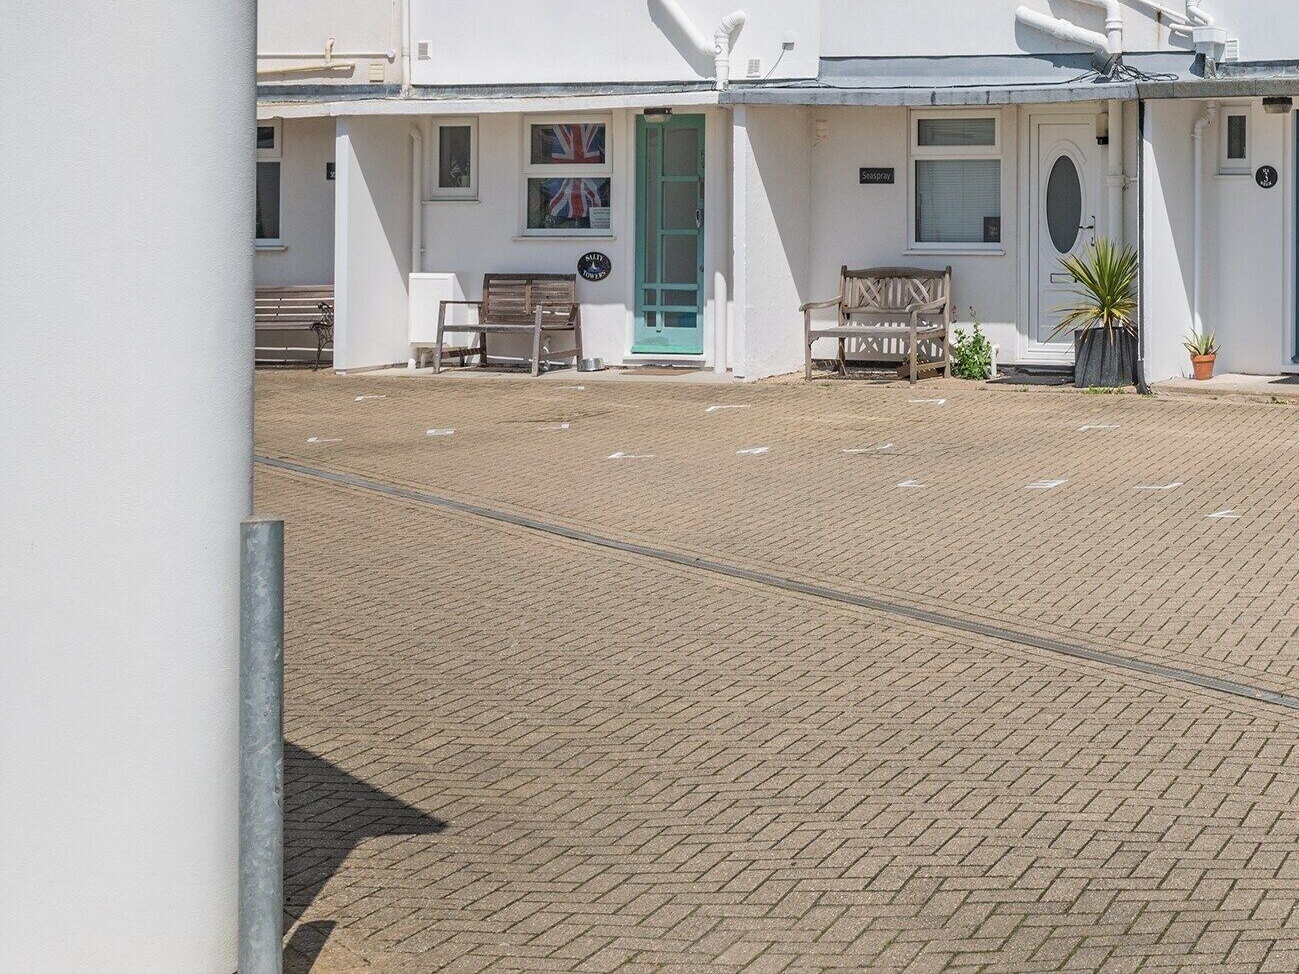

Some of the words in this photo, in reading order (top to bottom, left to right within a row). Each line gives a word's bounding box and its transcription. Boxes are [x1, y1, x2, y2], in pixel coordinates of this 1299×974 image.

[862, 170, 891, 181] Seaspray
[585, 253, 603, 262] SALTY
[582, 269, 606, 279] TOWERS
